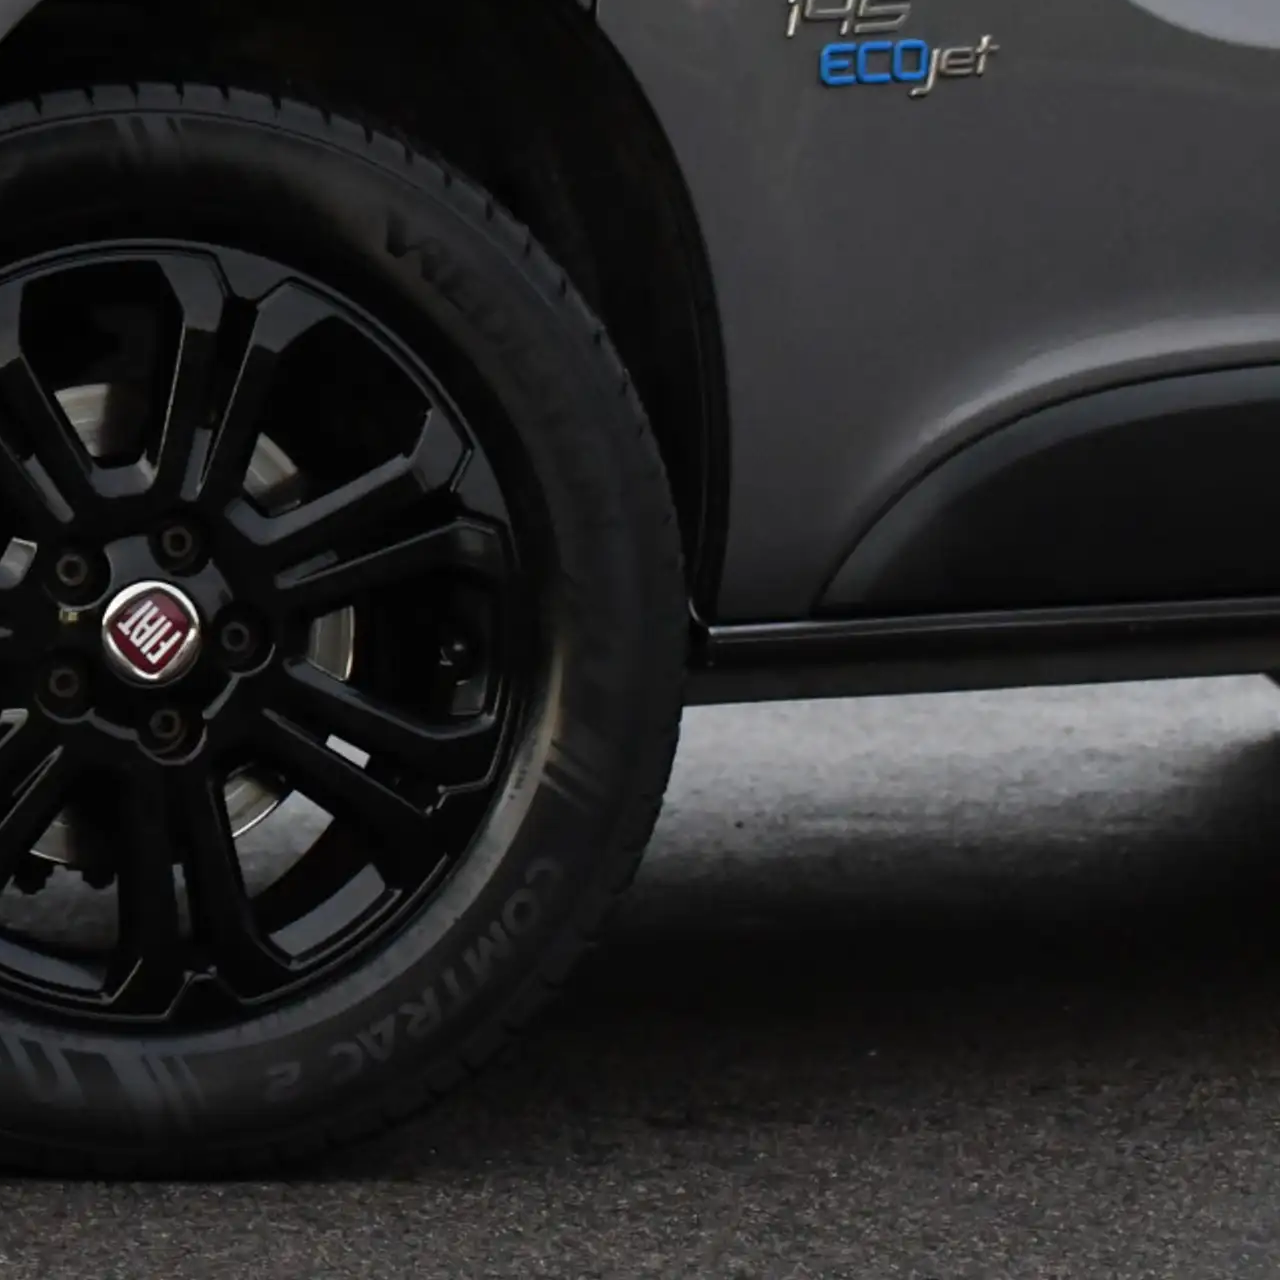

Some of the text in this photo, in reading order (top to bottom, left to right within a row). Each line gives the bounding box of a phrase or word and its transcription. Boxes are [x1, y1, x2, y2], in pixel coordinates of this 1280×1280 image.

[819, 34, 1000, 97] ECOjet
[116, 599, 183, 665] FIAT
[326, 856, 566, 1080] COMTRAC
